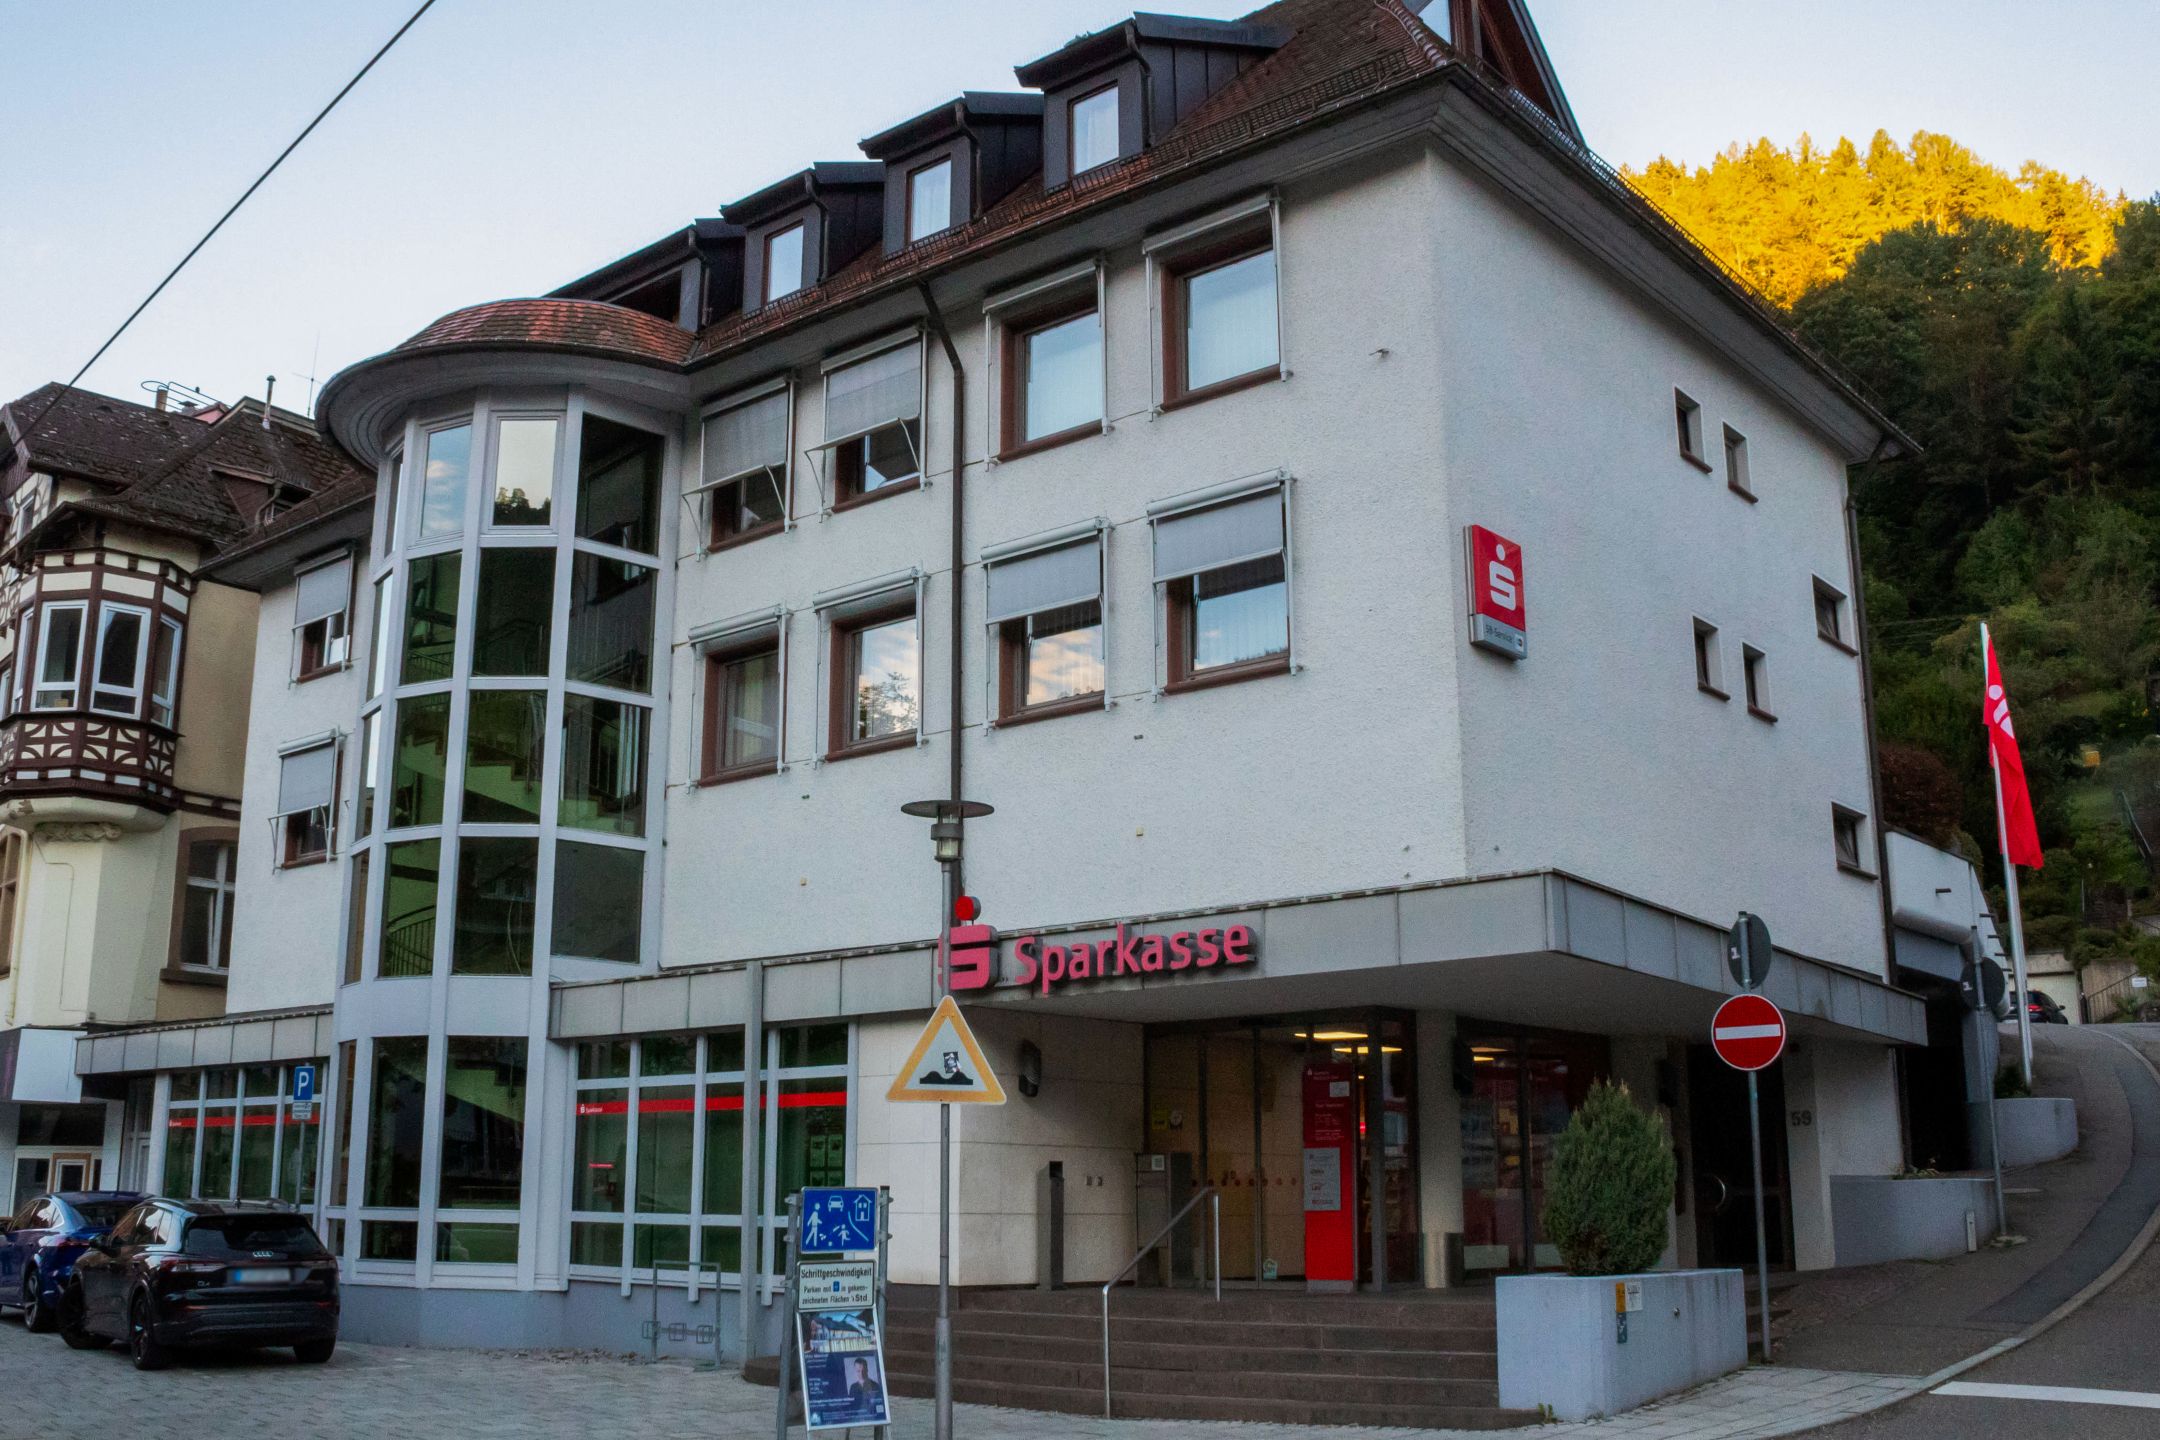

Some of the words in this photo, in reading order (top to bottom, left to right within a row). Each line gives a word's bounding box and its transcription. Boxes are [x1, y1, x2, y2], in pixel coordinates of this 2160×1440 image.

[1014, 921, 1252, 995] Sparkasse
[297, 1071, 310, 1097] P
[801, 1268, 872, 1280] Schrittgeschwindigkeit
